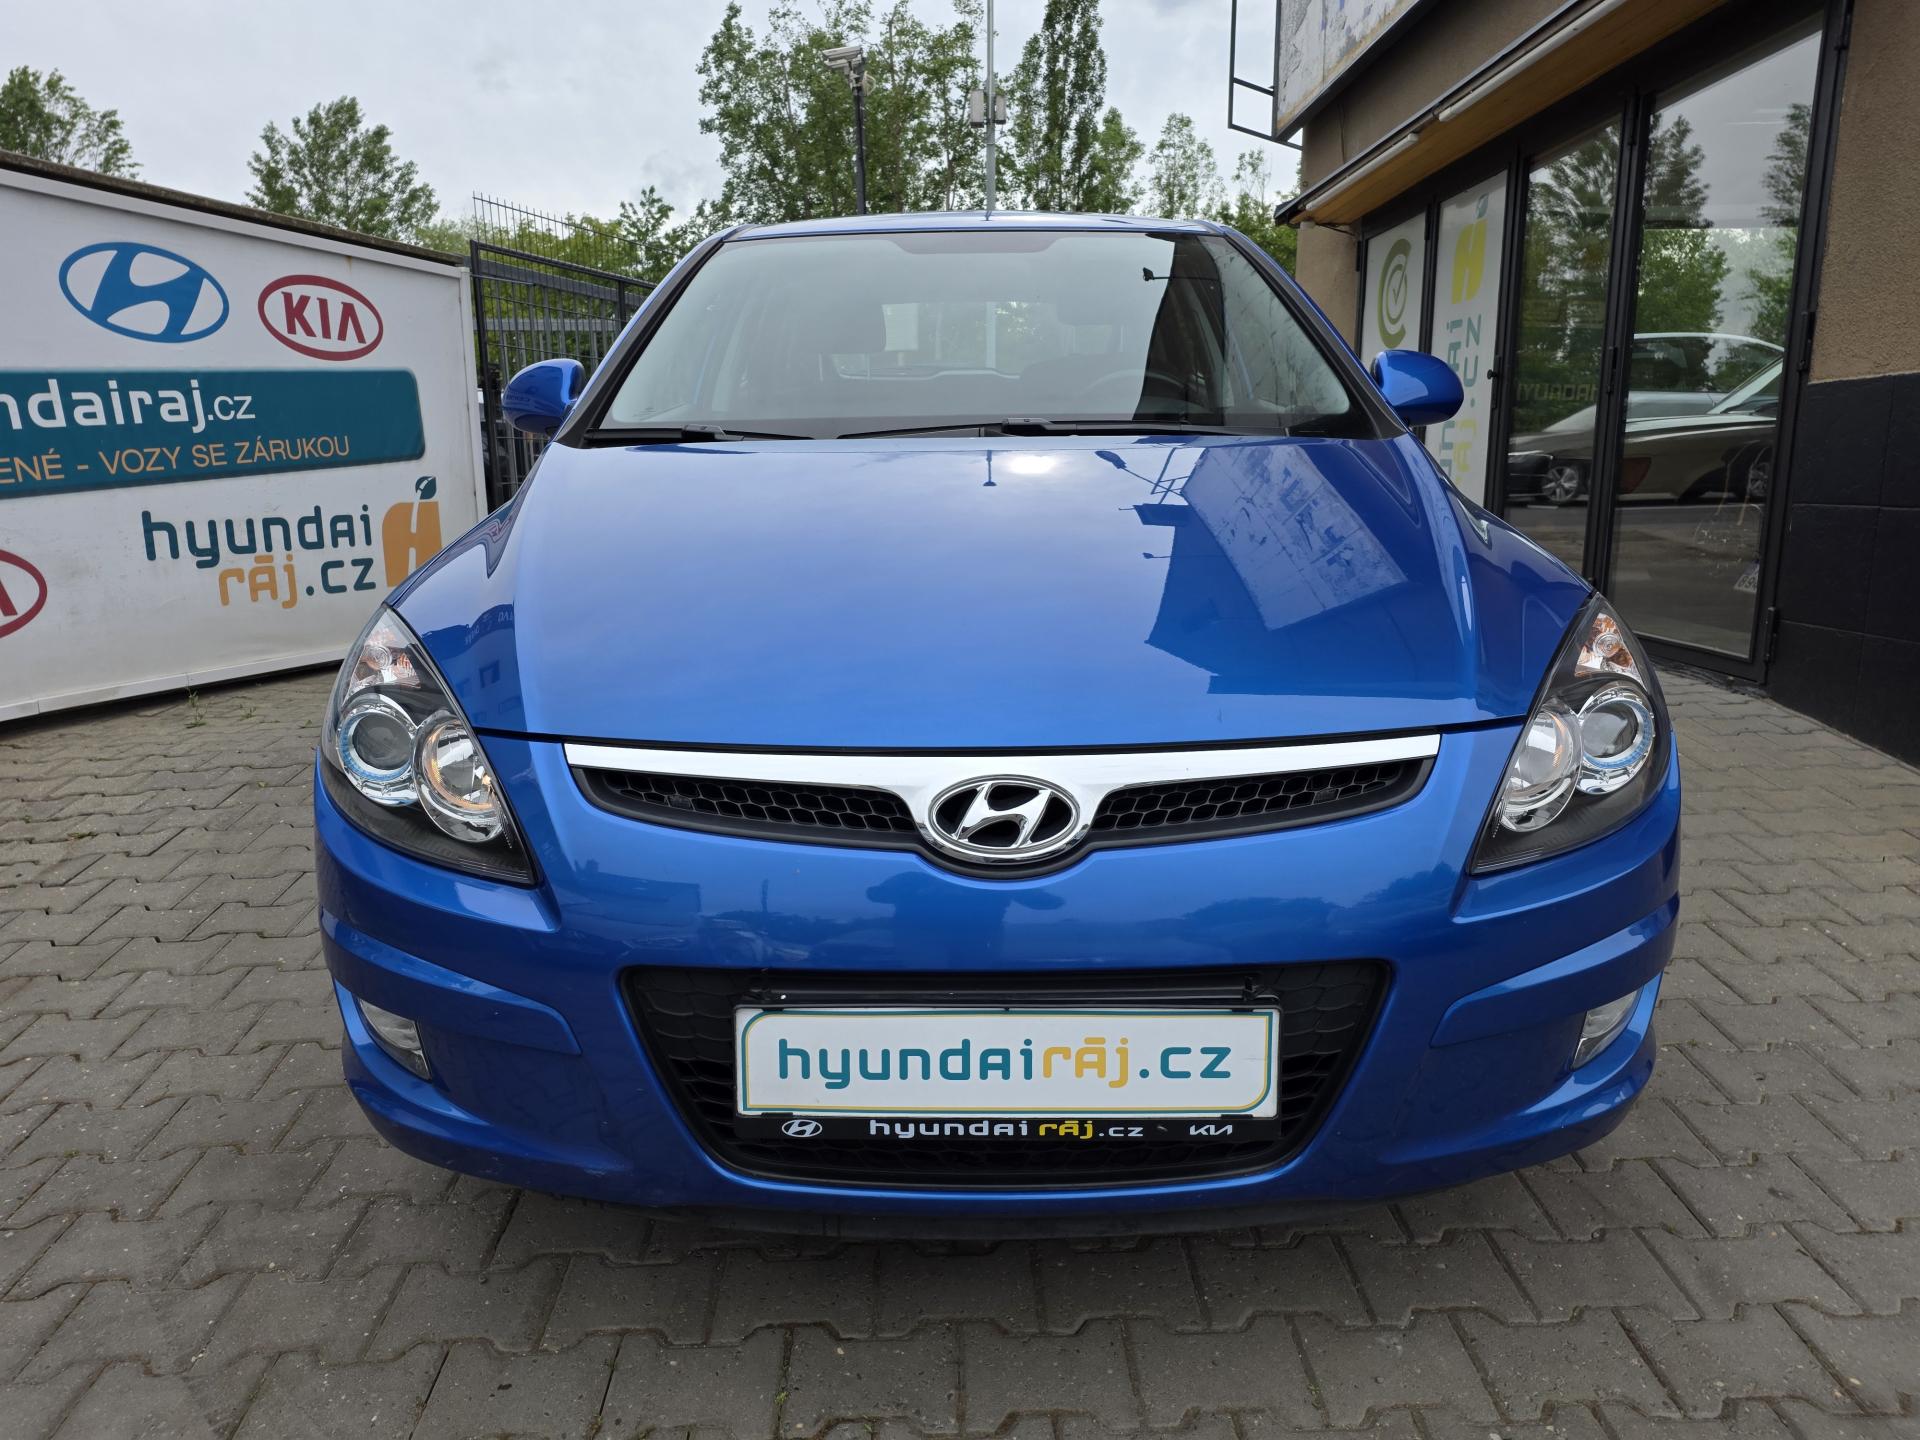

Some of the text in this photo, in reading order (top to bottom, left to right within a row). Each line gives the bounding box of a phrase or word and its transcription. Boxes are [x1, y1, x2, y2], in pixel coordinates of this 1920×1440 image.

[281, 291, 366, 344] KIA
[98, 446, 181, 475] VOZY
[191, 443, 228, 468] SE
[234, 435, 350, 465] ZÁRUKOU
